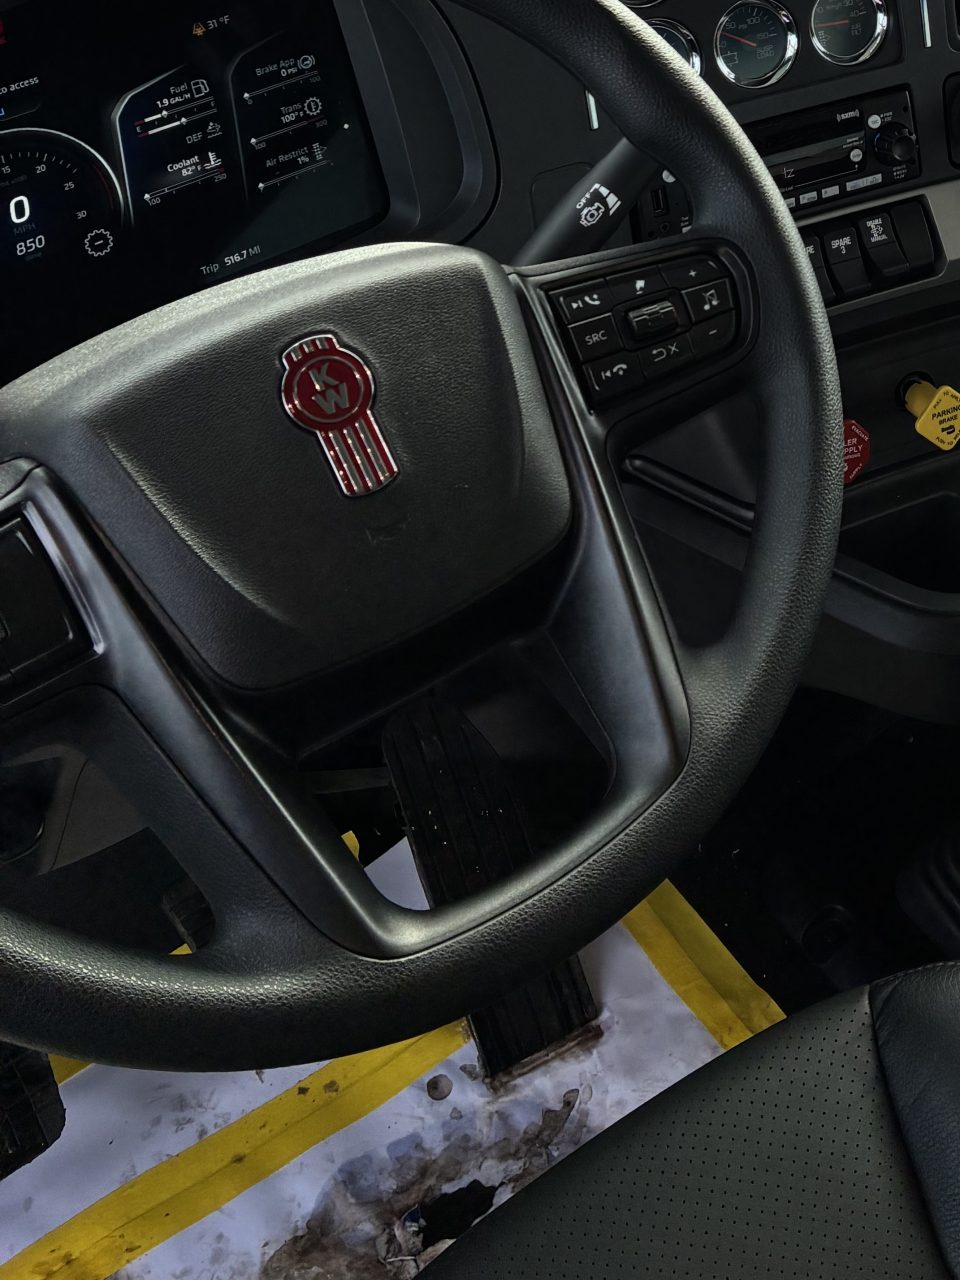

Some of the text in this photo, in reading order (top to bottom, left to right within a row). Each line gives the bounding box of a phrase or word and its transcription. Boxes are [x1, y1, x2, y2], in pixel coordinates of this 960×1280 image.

[206, 19, 219, 30] 31
[255, 57, 295, 76] Brake App
[9, 76, 40, 92] access
[170, 82, 188, 95] Fuel
[156, 98, 169, 109] 1.9
[280, 102, 302, 115] Trans
[186, 131, 203, 144] DEF
[167, 155, 200, 172] Coolant
[266, 146, 309, 168] Air Restrict
[297, 155, 310, 165] 1%
[35, 164, 47, 174] 20
[63, 181, 75, 191] 25
[576, 191, 592, 209] OFF
[9, 195, 30, 223] 0
[75, 210, 87, 220] 30
[13, 222, 37, 236] MPH
[16, 234, 46, 256] 850
[831, 236, 852, 249] SPARE
[840, 246, 846, 254] 3
[200, 245, 261, 275] Trip 516.7 MI
[585, 330, 608, 346] SRC
[939, 414, 958, 425] BRAKE
